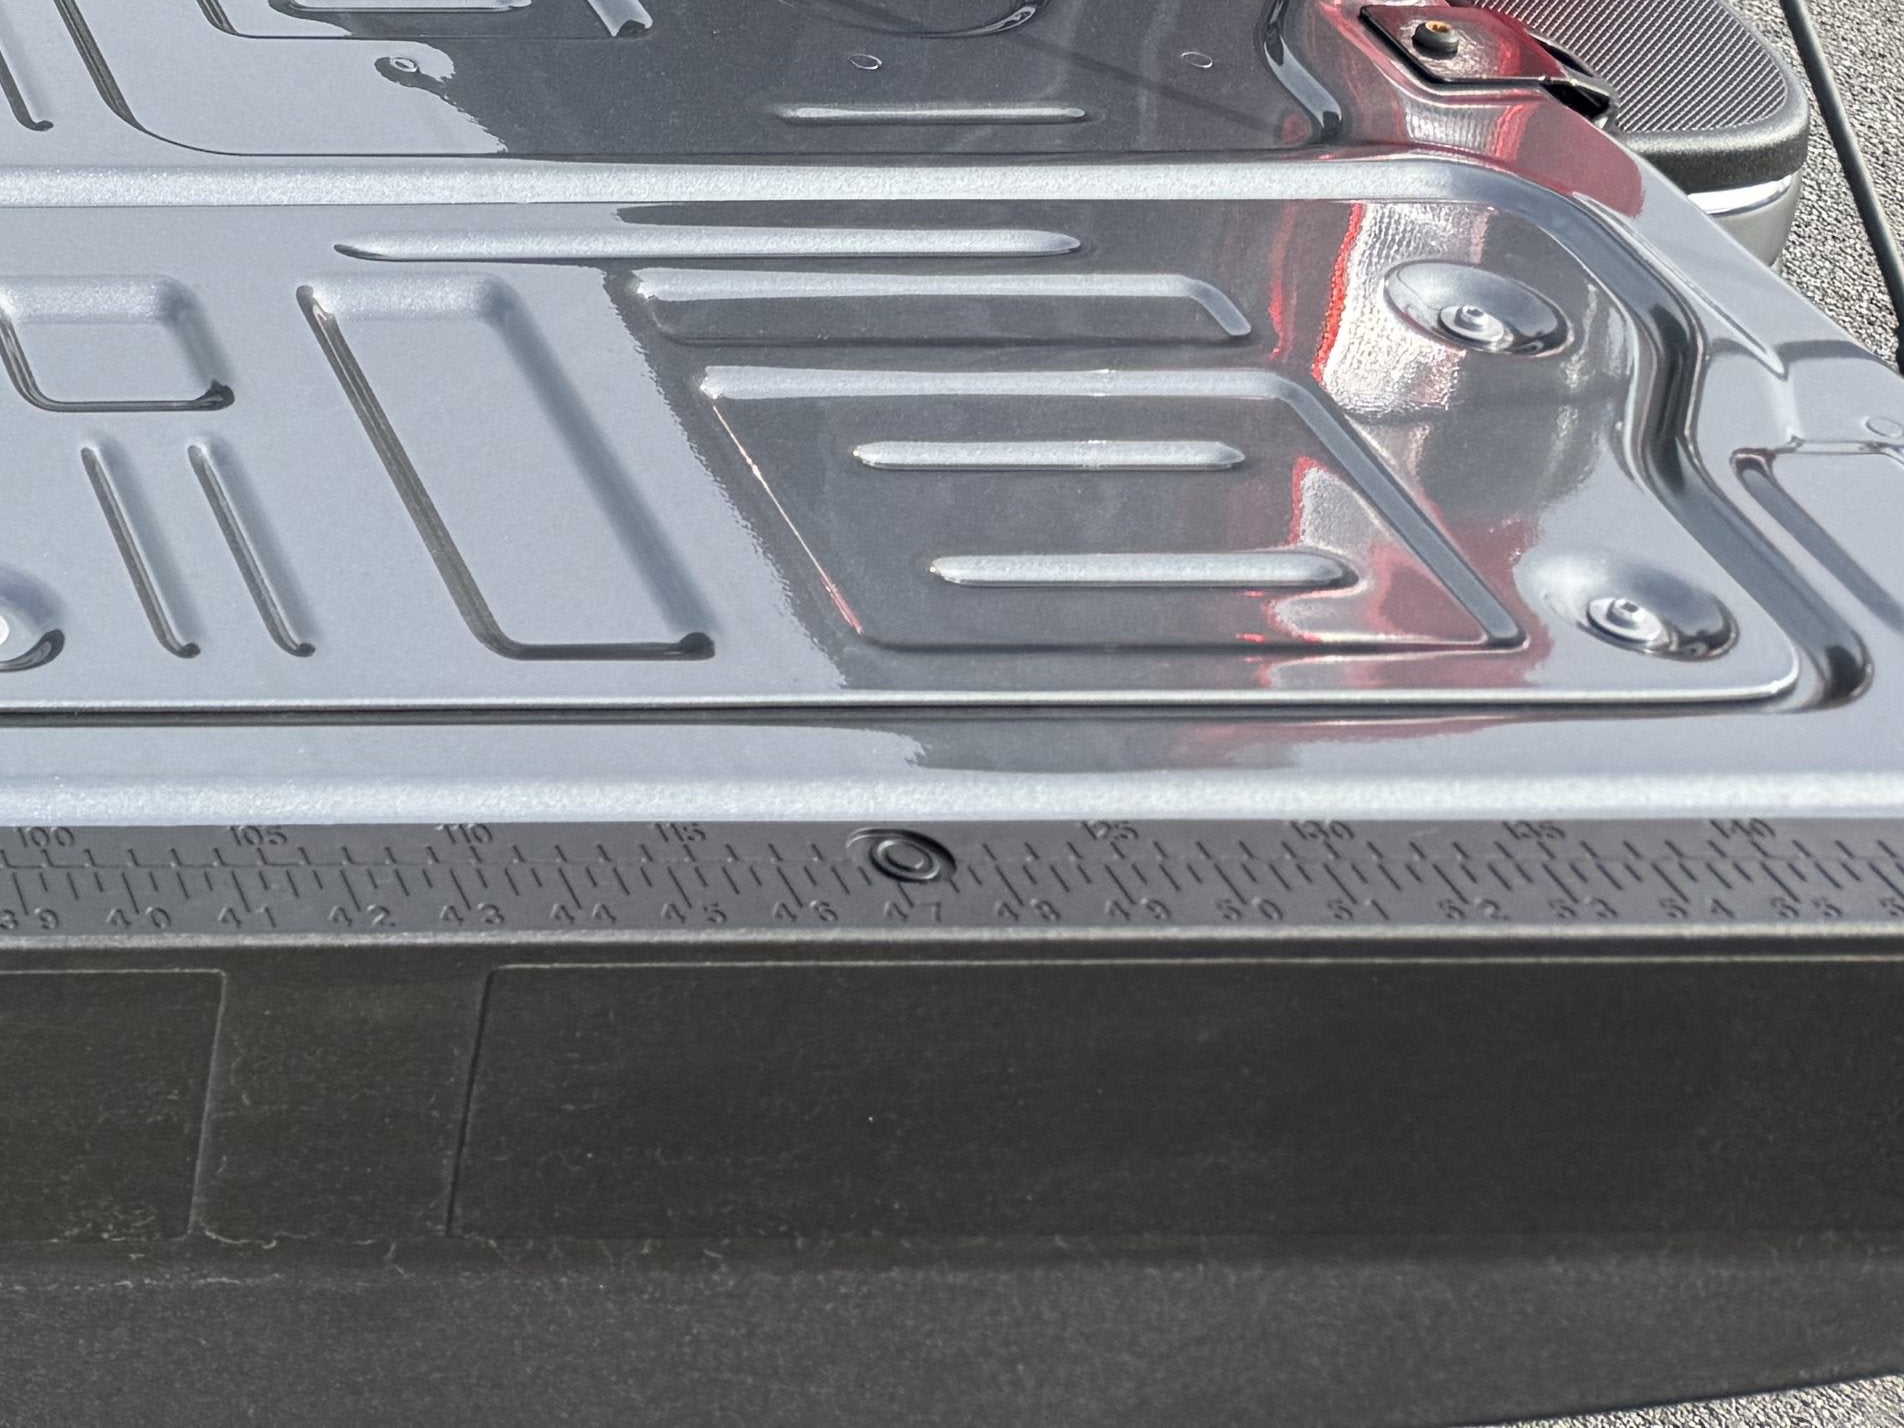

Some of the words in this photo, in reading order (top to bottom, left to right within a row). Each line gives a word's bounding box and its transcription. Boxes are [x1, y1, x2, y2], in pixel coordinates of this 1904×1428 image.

[17, 826, 75, 848] 100
[106, 906, 172, 930] 40
[217, 905, 276, 929] 41
[328, 904, 397, 928] 42
[439, 902, 505, 926] 43
[550, 902, 617, 926] 44
[661, 901, 728, 925] 45
[773, 900, 838, 924] 46
[883, 900, 942, 923] 47
[995, 898, 1061, 923] 48
[1105, 897, 1172, 922] 49
